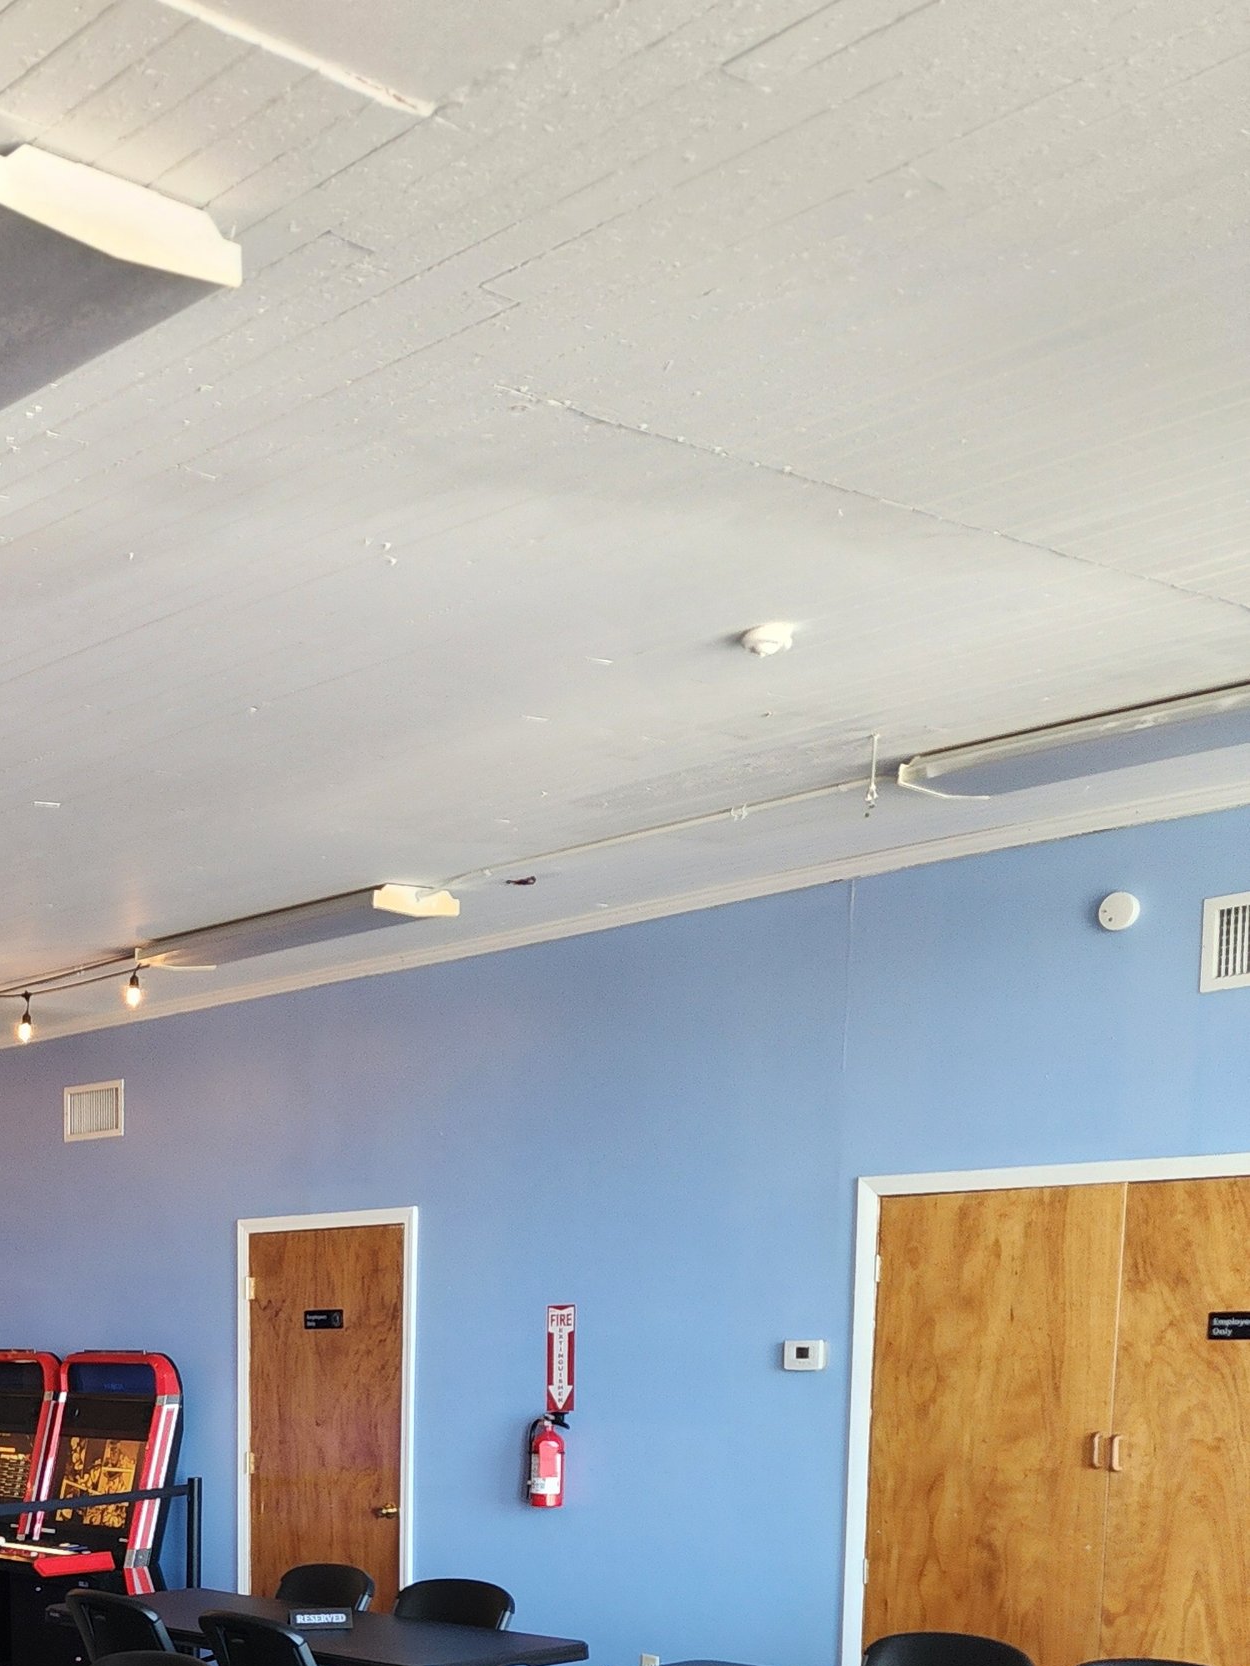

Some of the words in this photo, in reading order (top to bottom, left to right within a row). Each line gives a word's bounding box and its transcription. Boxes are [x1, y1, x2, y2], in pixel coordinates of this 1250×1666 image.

[550, 1313, 572, 1327] FIRE
[1212, 1328, 1232, 1337] Only
[295, 1613, 347, 1624] RESERVED
